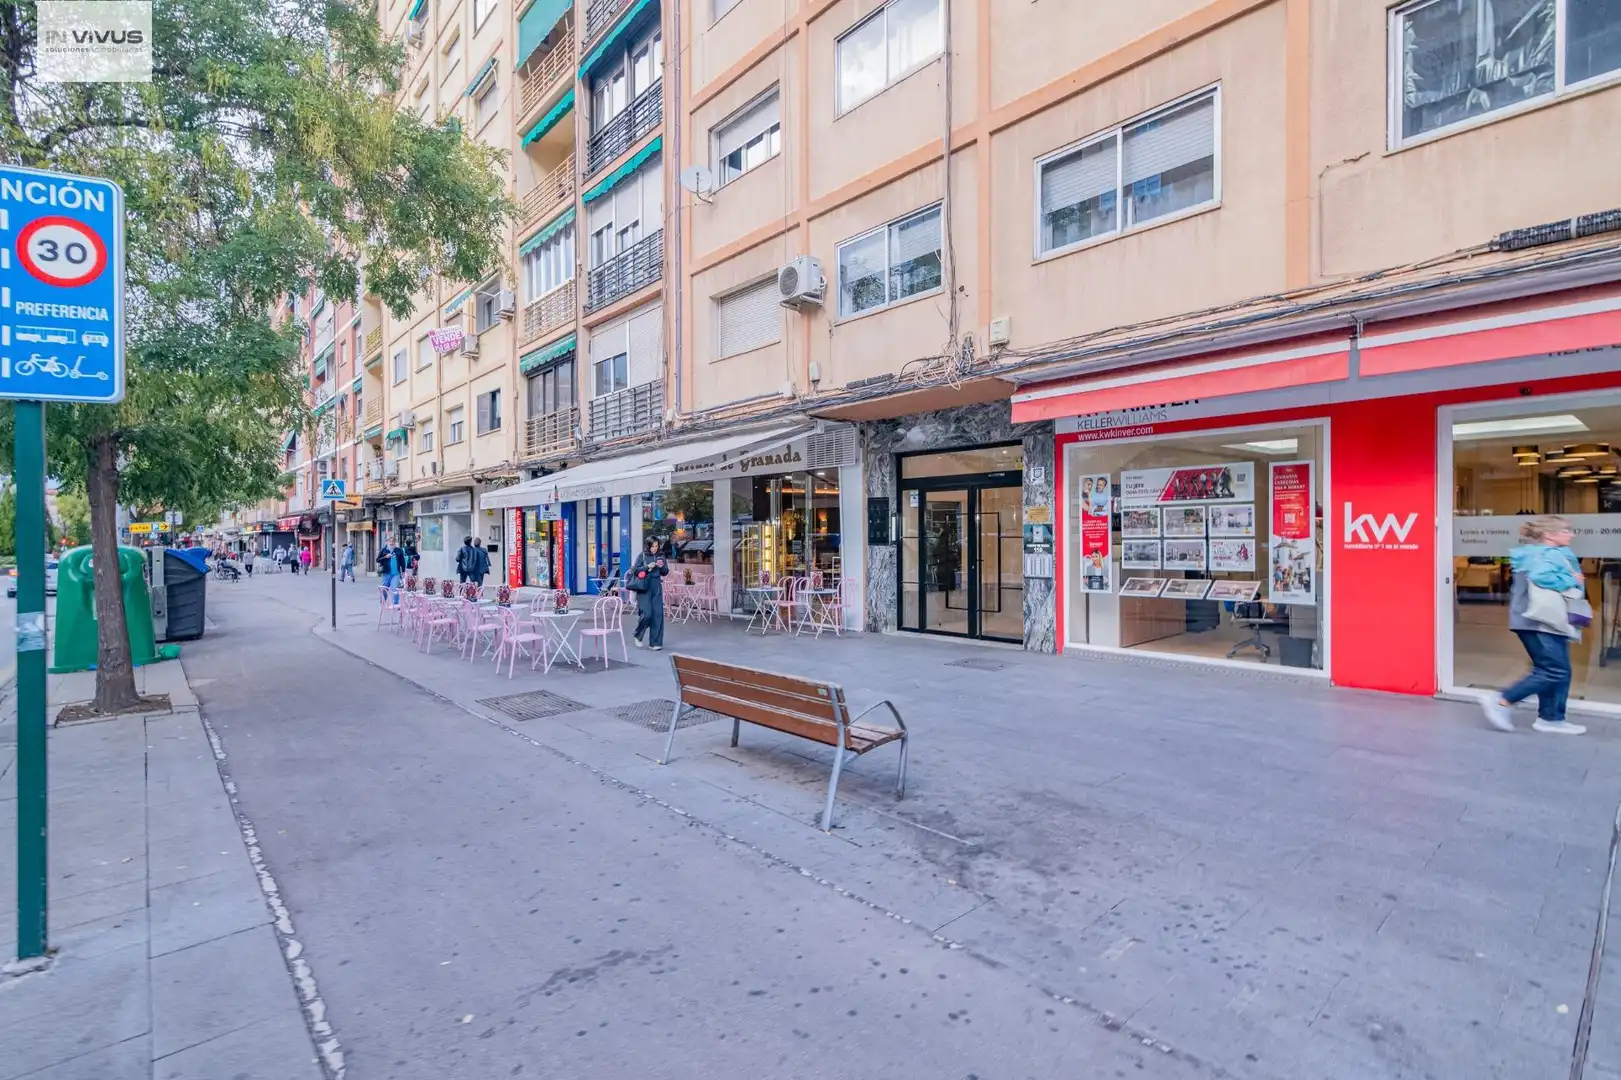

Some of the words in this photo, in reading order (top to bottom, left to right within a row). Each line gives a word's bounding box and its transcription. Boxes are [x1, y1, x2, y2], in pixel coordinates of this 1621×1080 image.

[0, 177, 105, 212] NCIÓN
[37, 239, 88, 265] 30
[15, 301, 109, 321] PREFERENCIA
[1078, 425, 1154, 442] www.kwkinver.com
[1344, 501, 1418, 543] kw
